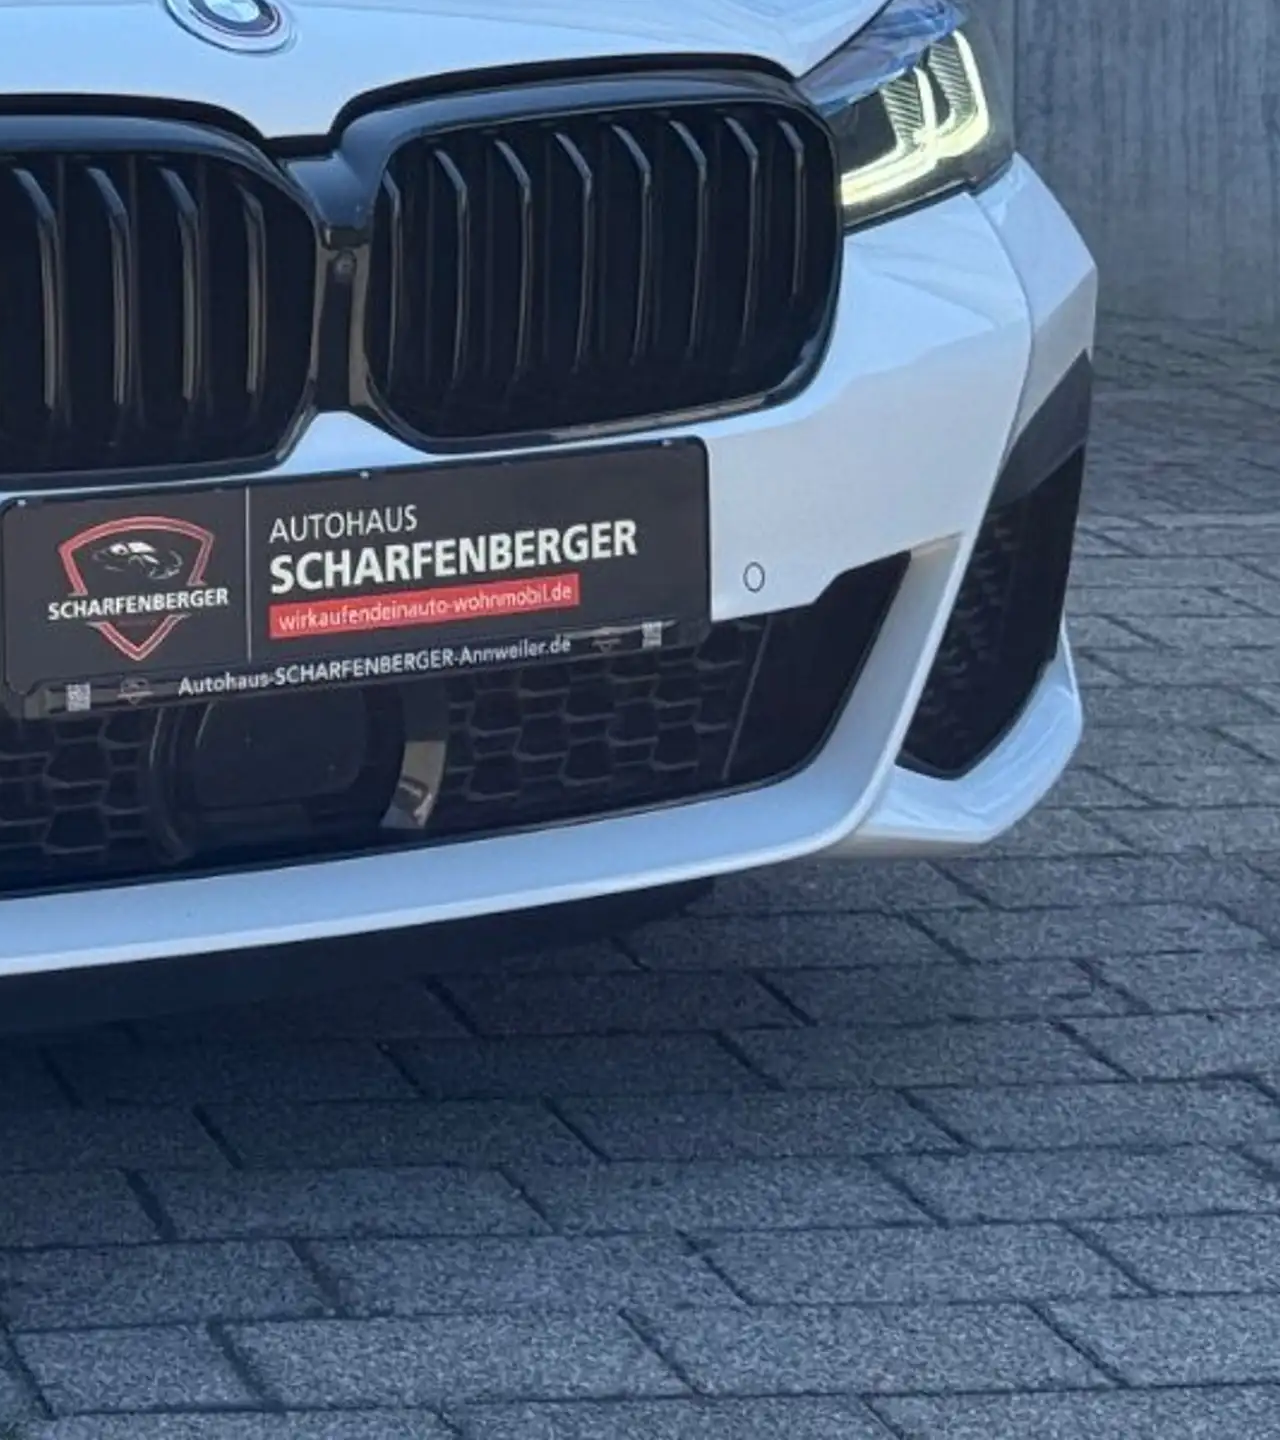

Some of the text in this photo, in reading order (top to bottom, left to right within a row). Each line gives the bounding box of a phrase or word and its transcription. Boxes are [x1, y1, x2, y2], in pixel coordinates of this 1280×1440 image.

[269, 505, 417, 543] AUTOHAUS
[270, 520, 638, 594] SCHARFENBERGER
[48, 588, 228, 620] SCHARFENBERGER
[279, 583, 572, 632] wirkaufendeinauto-wohnmobil.de
[178, 636, 571, 696] Autohaus-SCHARFENBERGER-Annweiler.de
